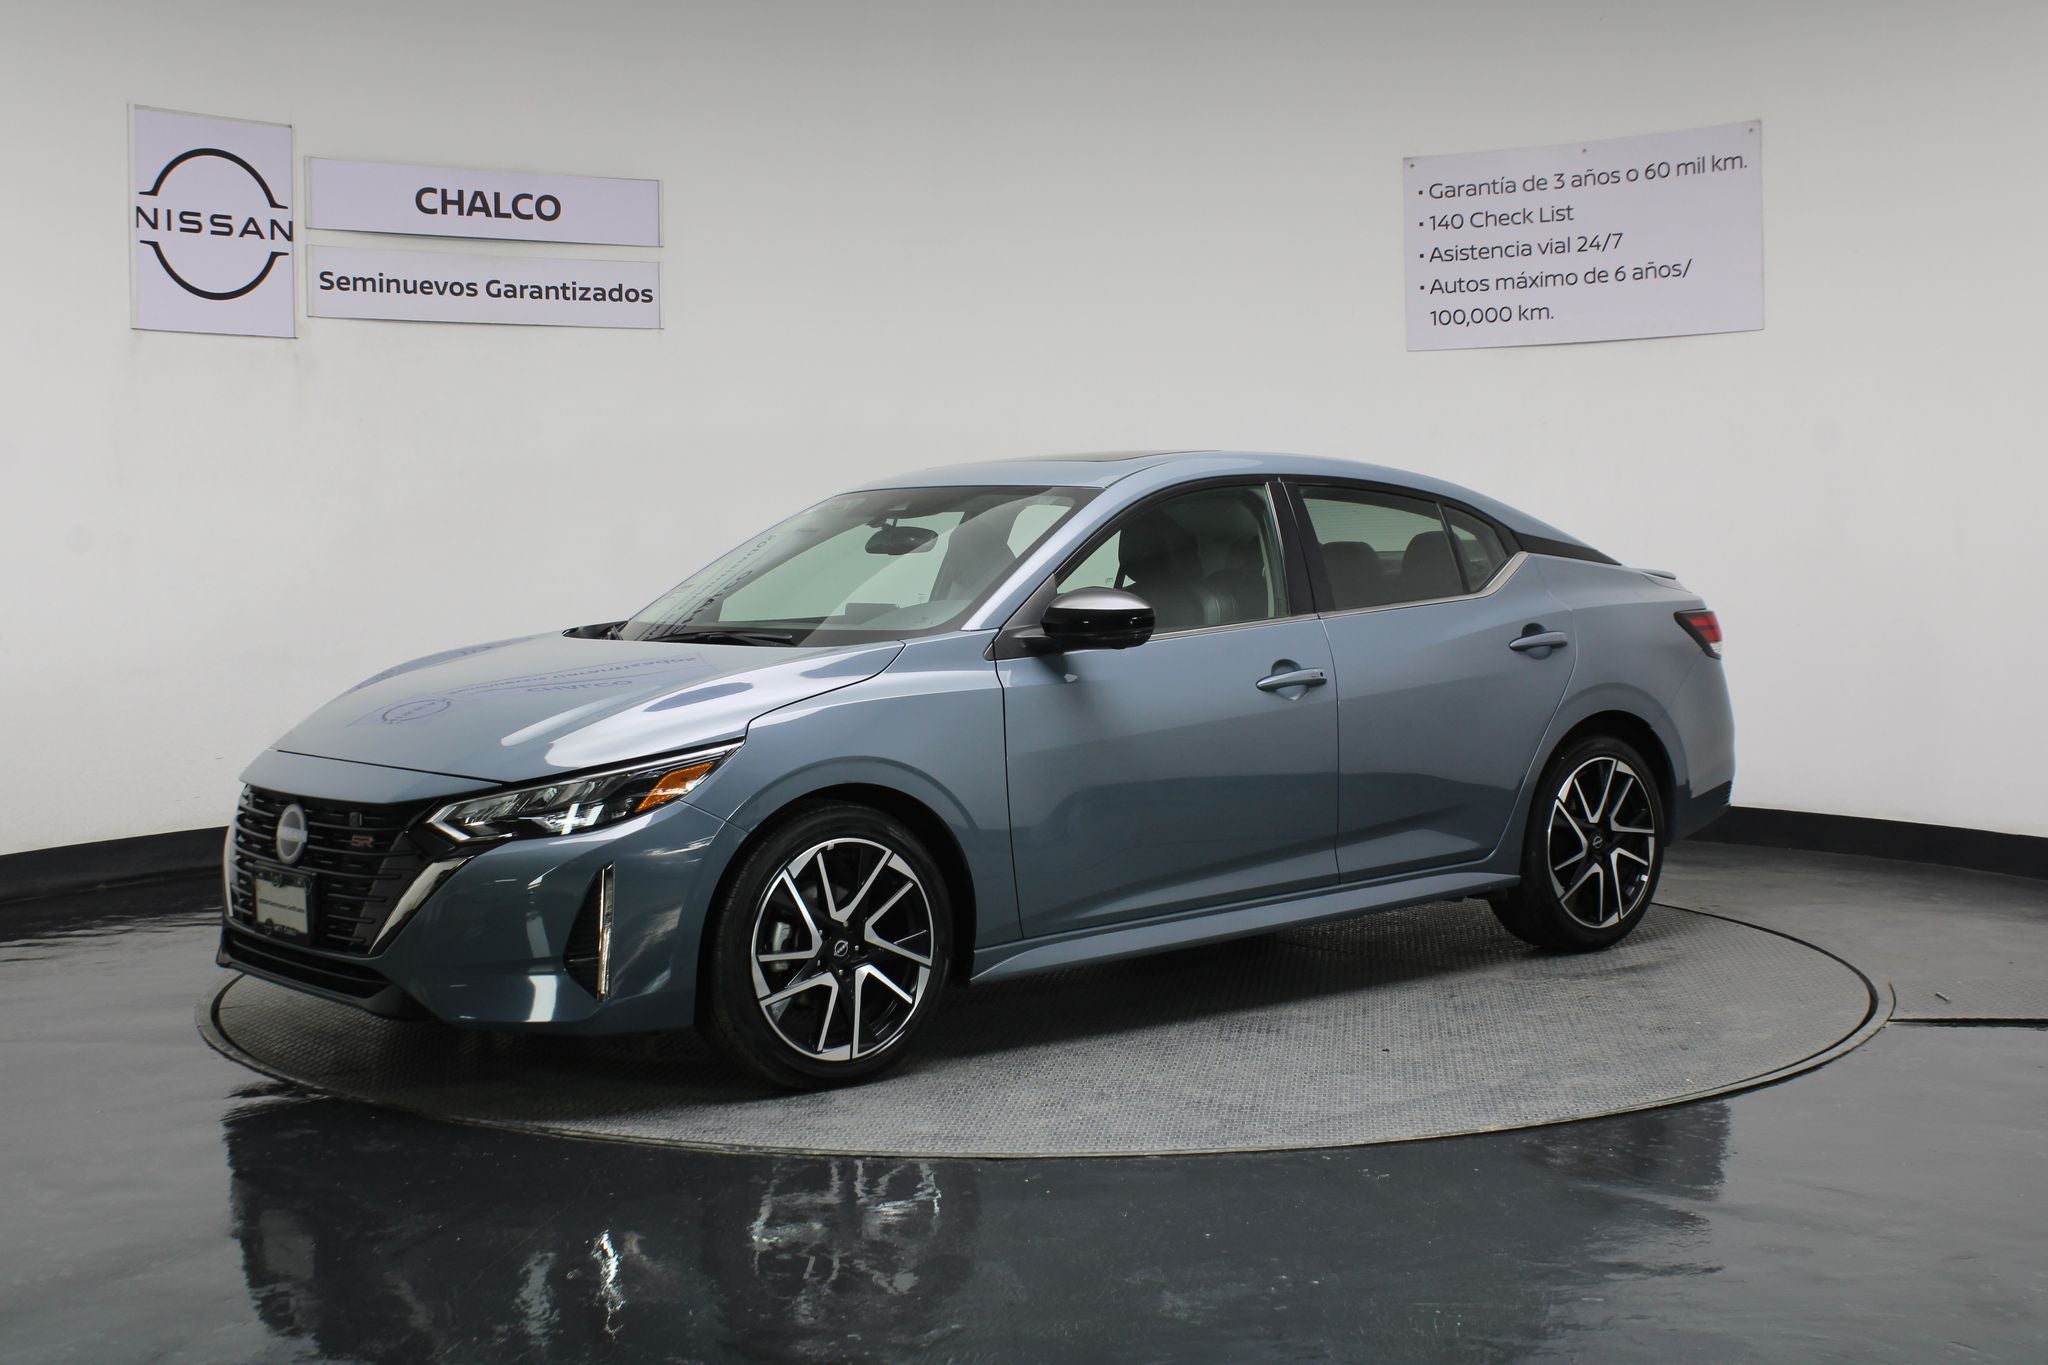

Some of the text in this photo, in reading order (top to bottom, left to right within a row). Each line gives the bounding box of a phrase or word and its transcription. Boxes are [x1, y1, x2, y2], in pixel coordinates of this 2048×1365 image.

[1428, 153, 1748, 200] Garantía de 3 años o 60 mil km.
[414, 186, 562, 222] CHALCO
[1428, 204, 1575, 231] 140 Check List
[135, 205, 294, 243] NISSAN
[1429, 232, 1624, 263] Asistencia vial 24/7
[319, 270, 654, 304] Seminuevos Garantizados
[1429, 258, 1693, 295] Autos máximo de 6 años/
[1429, 304, 1554, 328] 100,000 km.
[351, 834, 374, 848] SR
